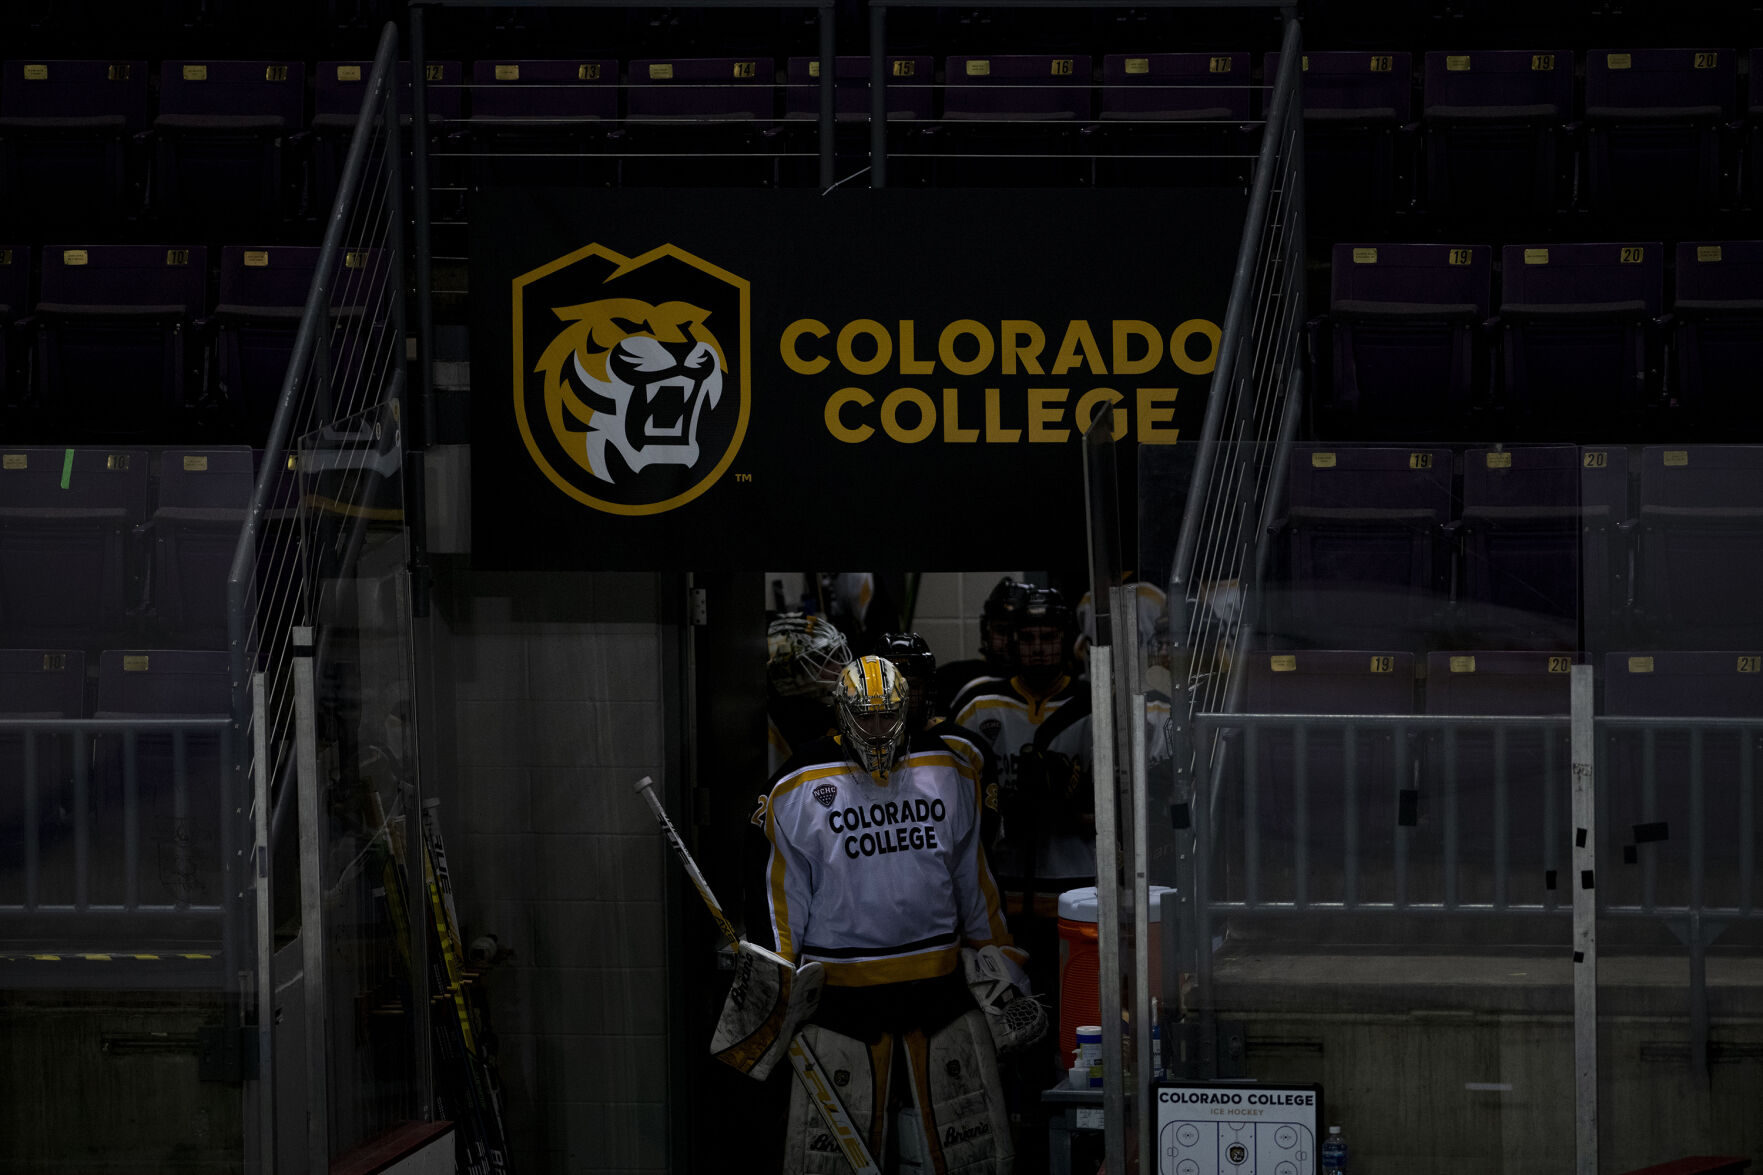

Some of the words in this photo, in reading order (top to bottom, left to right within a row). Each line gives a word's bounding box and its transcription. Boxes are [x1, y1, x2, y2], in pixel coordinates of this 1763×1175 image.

[1215, 58, 1227, 71] 17
[1376, 58, 1388, 71] 18
[1537, 56, 1550, 69] 19
[1698, 54, 1714, 67] 20
[427, 67, 440, 79] 12
[584, 66, 597, 78] 13
[738, 64, 751, 77] 14
[898, 63, 910, 76] 15
[1057, 61, 1069, 74] 16
[173, 251, 184, 264] 10
[1454, 251, 1467, 264] 19
[1624, 249, 1640, 262] 20
[780, 318, 1223, 376] COLORADO
[824, 388, 1180, 445] COLLEGE
[1415, 455, 1428, 468] 19
[1587, 453, 1603, 466] 20
[735, 473, 752, 483] TM
[1375, 657, 1389, 670] 19
[1551, 658, 1567, 671] 20
[1740, 657, 1756, 671] 21
[814, 785, 837, 797] NCHC
[829, 799, 946, 834] COLORADO
[845, 826, 938, 859] COLLEGE
[789, 1039, 869, 1169] TRUE
[1160, 1092, 1242, 1104] COLORADO
[1248, 1094, 1314, 1106] COLLEGE
